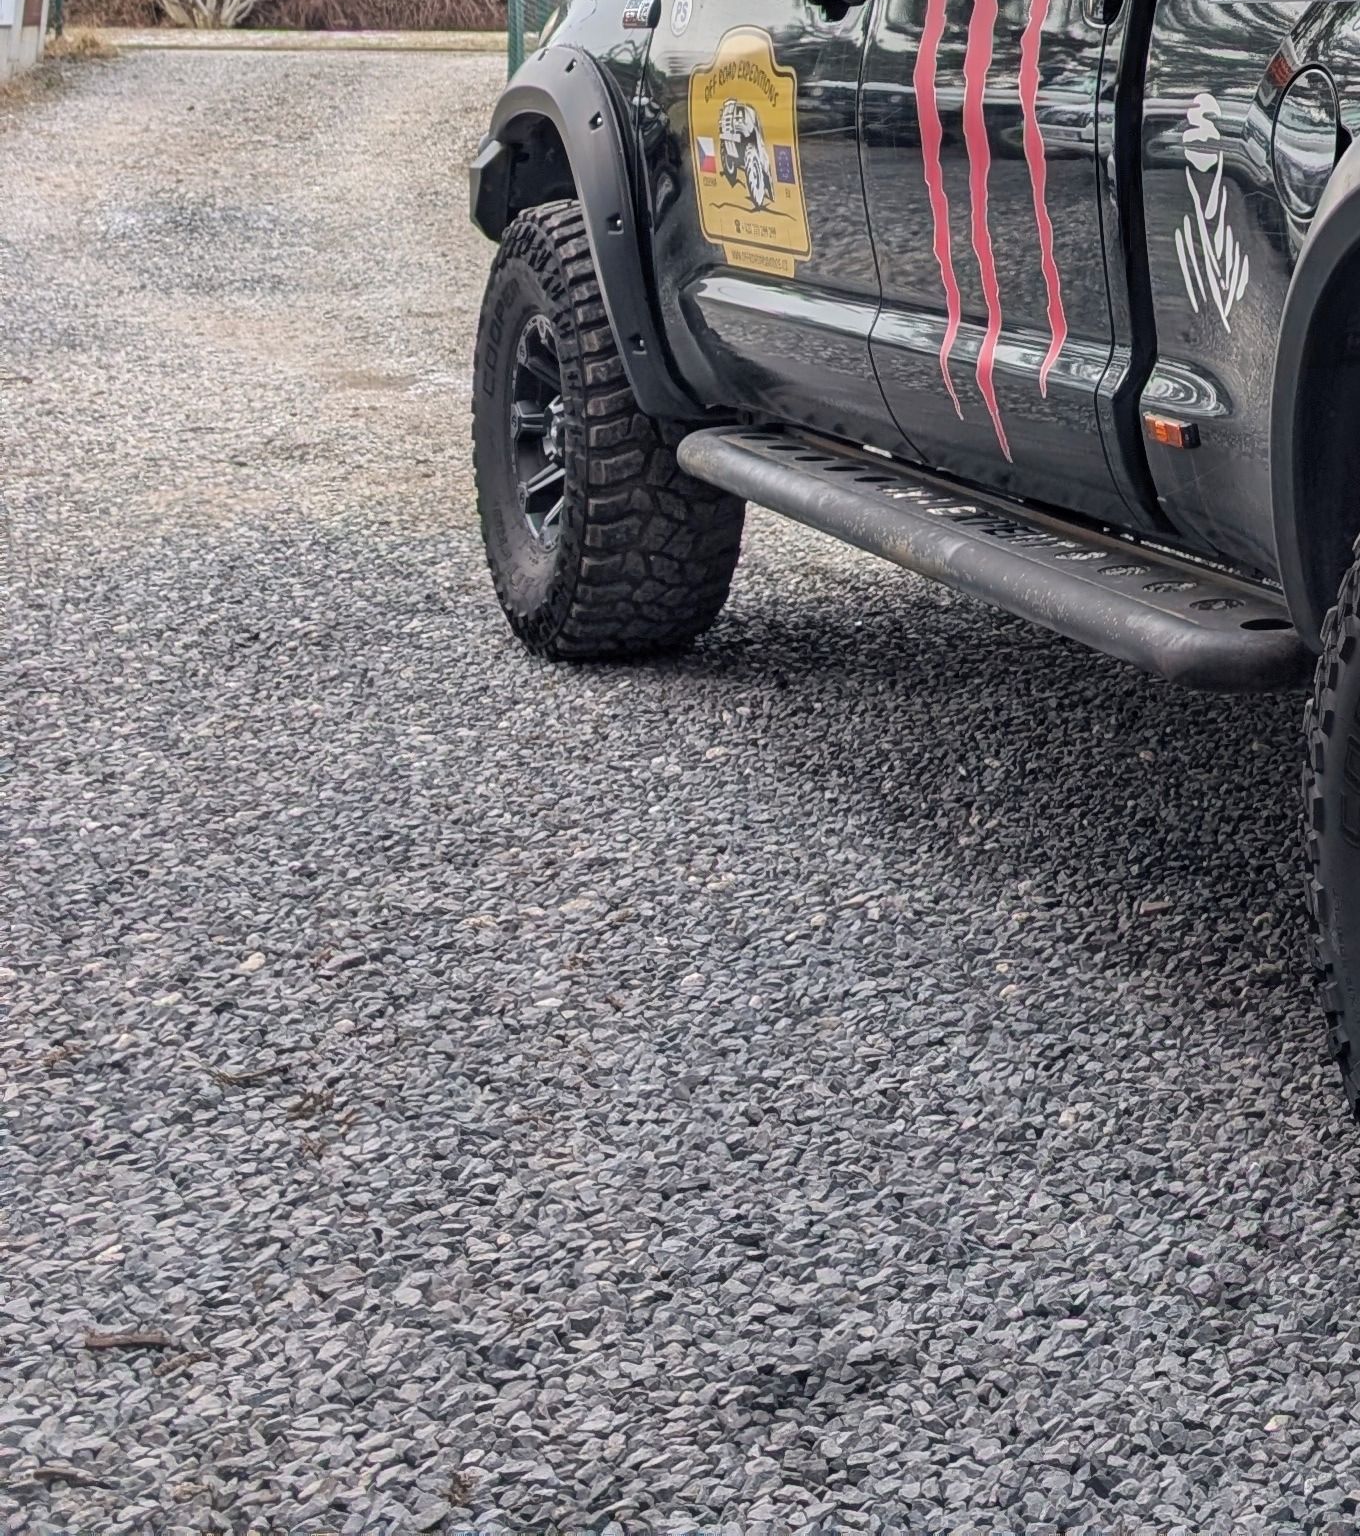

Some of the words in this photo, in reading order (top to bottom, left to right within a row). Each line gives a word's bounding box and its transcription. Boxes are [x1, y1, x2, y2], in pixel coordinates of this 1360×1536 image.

[704, 74, 717, 104] OFF
[718, 61, 737, 87] ROAD
[737, 60, 779, 108] EXPEDITIONS
